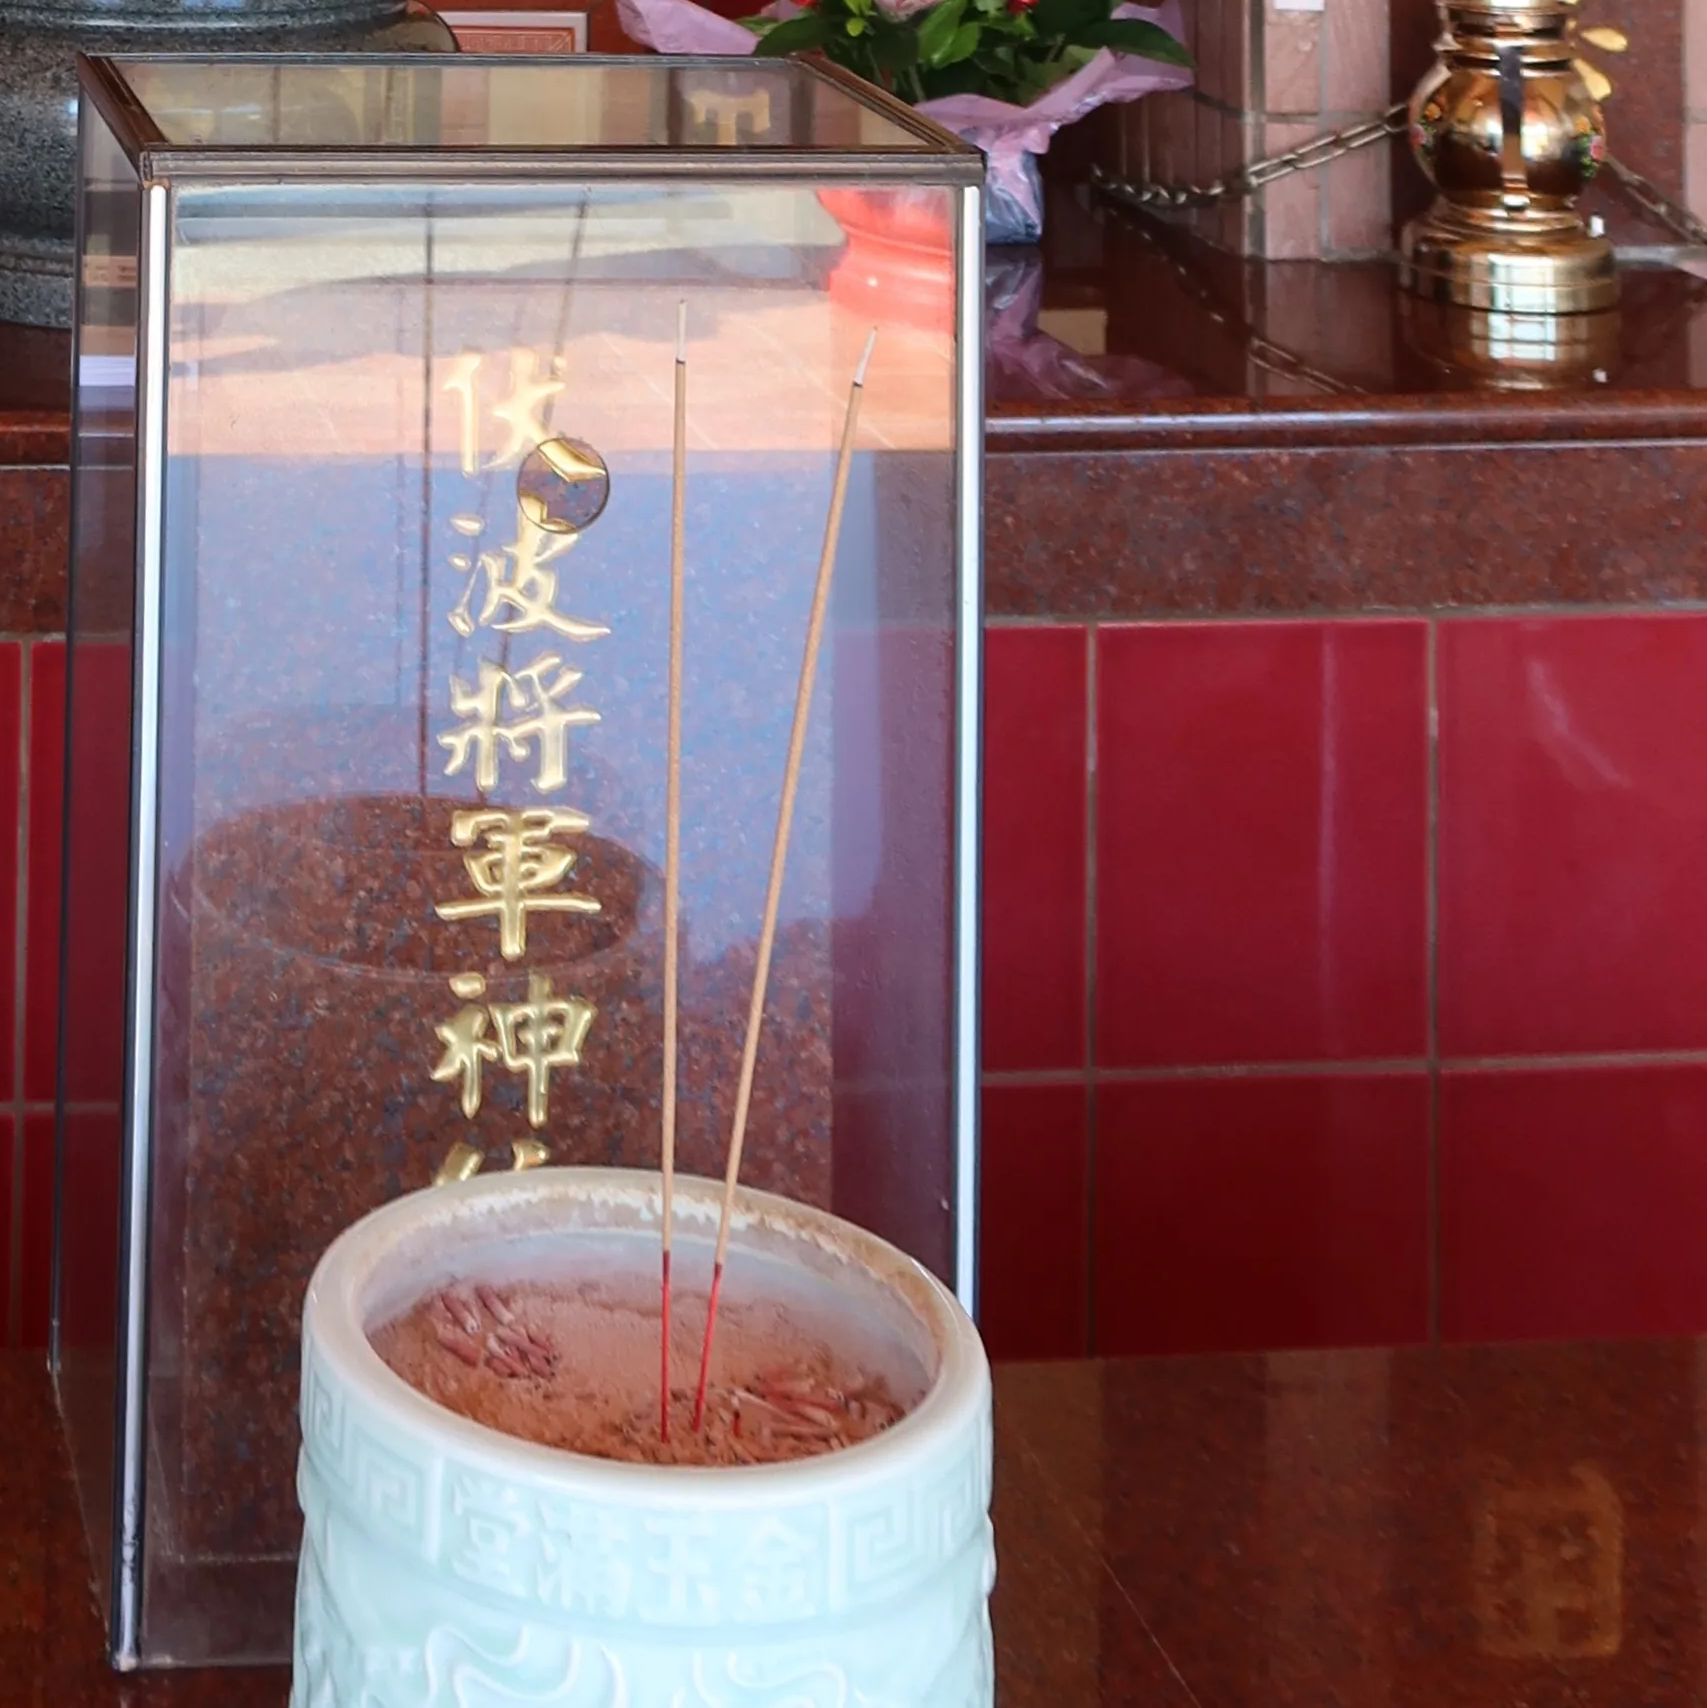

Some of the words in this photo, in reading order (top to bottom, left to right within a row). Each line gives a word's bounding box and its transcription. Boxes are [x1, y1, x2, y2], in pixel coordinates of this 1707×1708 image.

[430, 343, 612, 1186] 伏波將軍神
